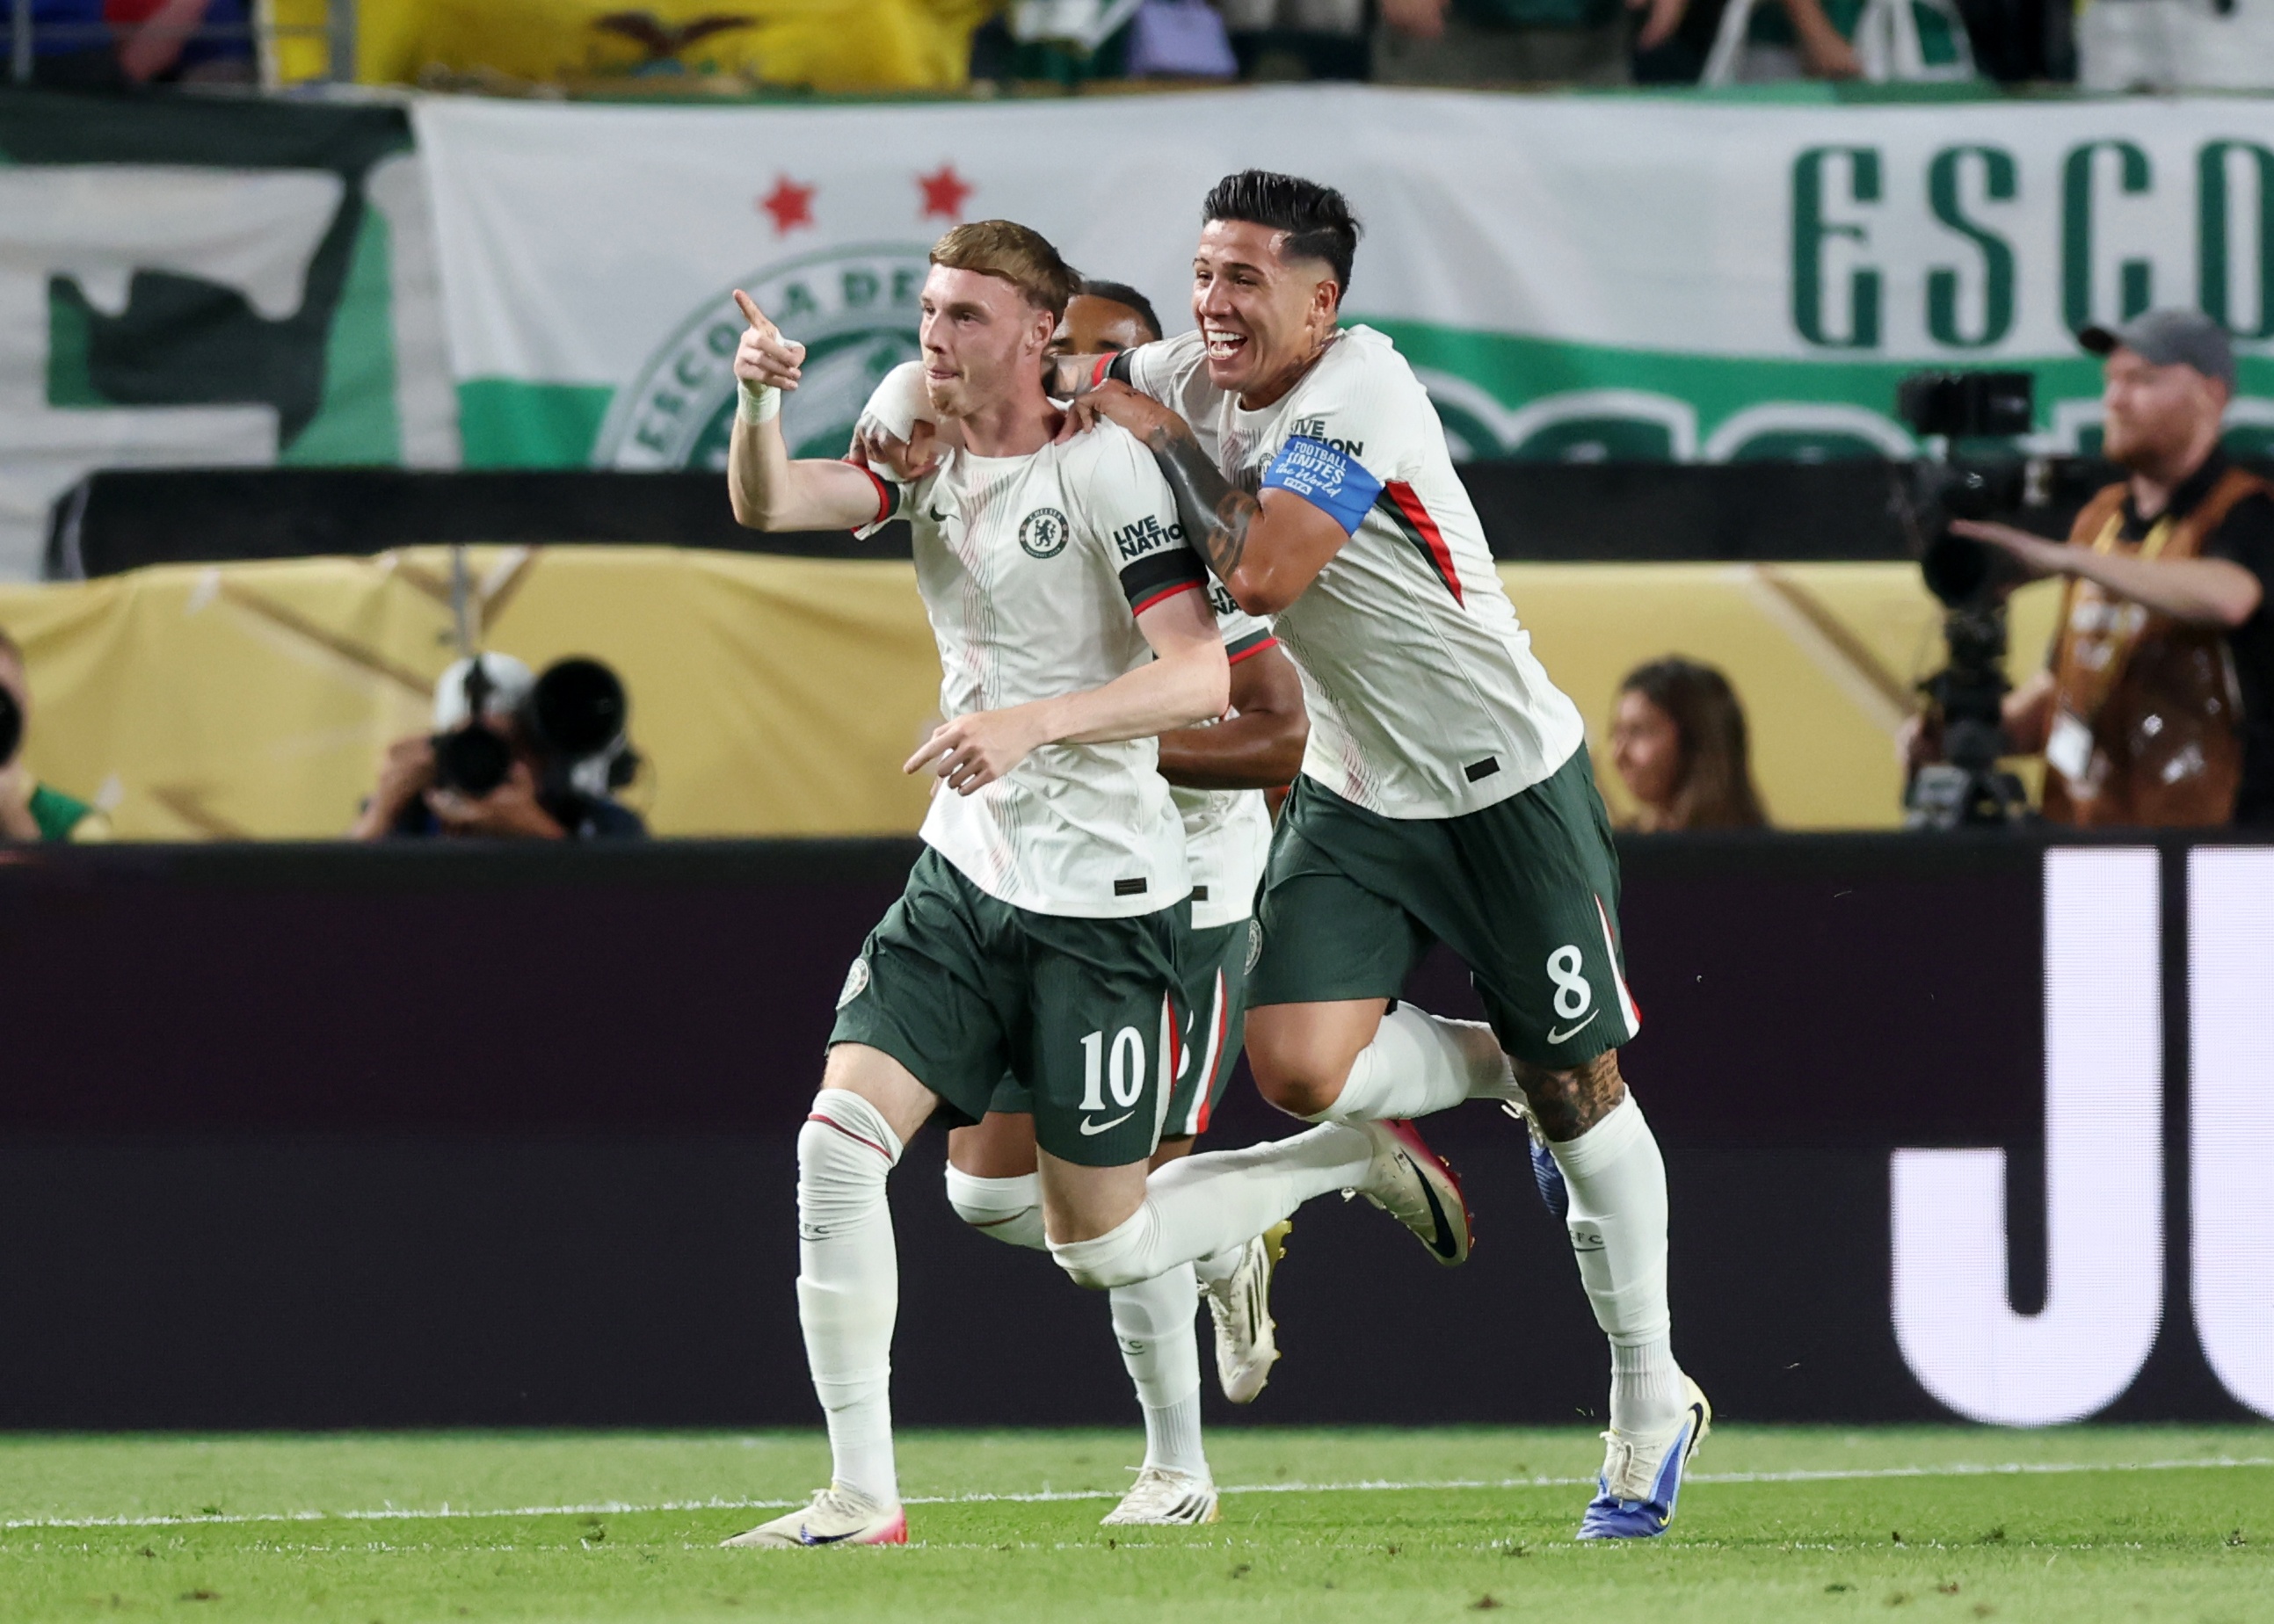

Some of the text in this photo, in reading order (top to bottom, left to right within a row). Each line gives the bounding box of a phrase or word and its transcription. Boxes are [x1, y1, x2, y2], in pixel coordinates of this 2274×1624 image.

[1789, 138, 2274, 349] ESCO
[635, 282, 819, 453] ESCOA
[1286, 452, 1346, 485] UNITES
[1293, 440, 1347, 472] FOOTBALL
[1275, 462, 1296, 475] the
[1295, 468, 1342, 498] World
[1113, 514, 1161, 546] LIVE
[1119, 523, 1184, 562] NATIO
[1546, 944, 1592, 1020] 8
[1078, 1025, 1146, 1110] 10
